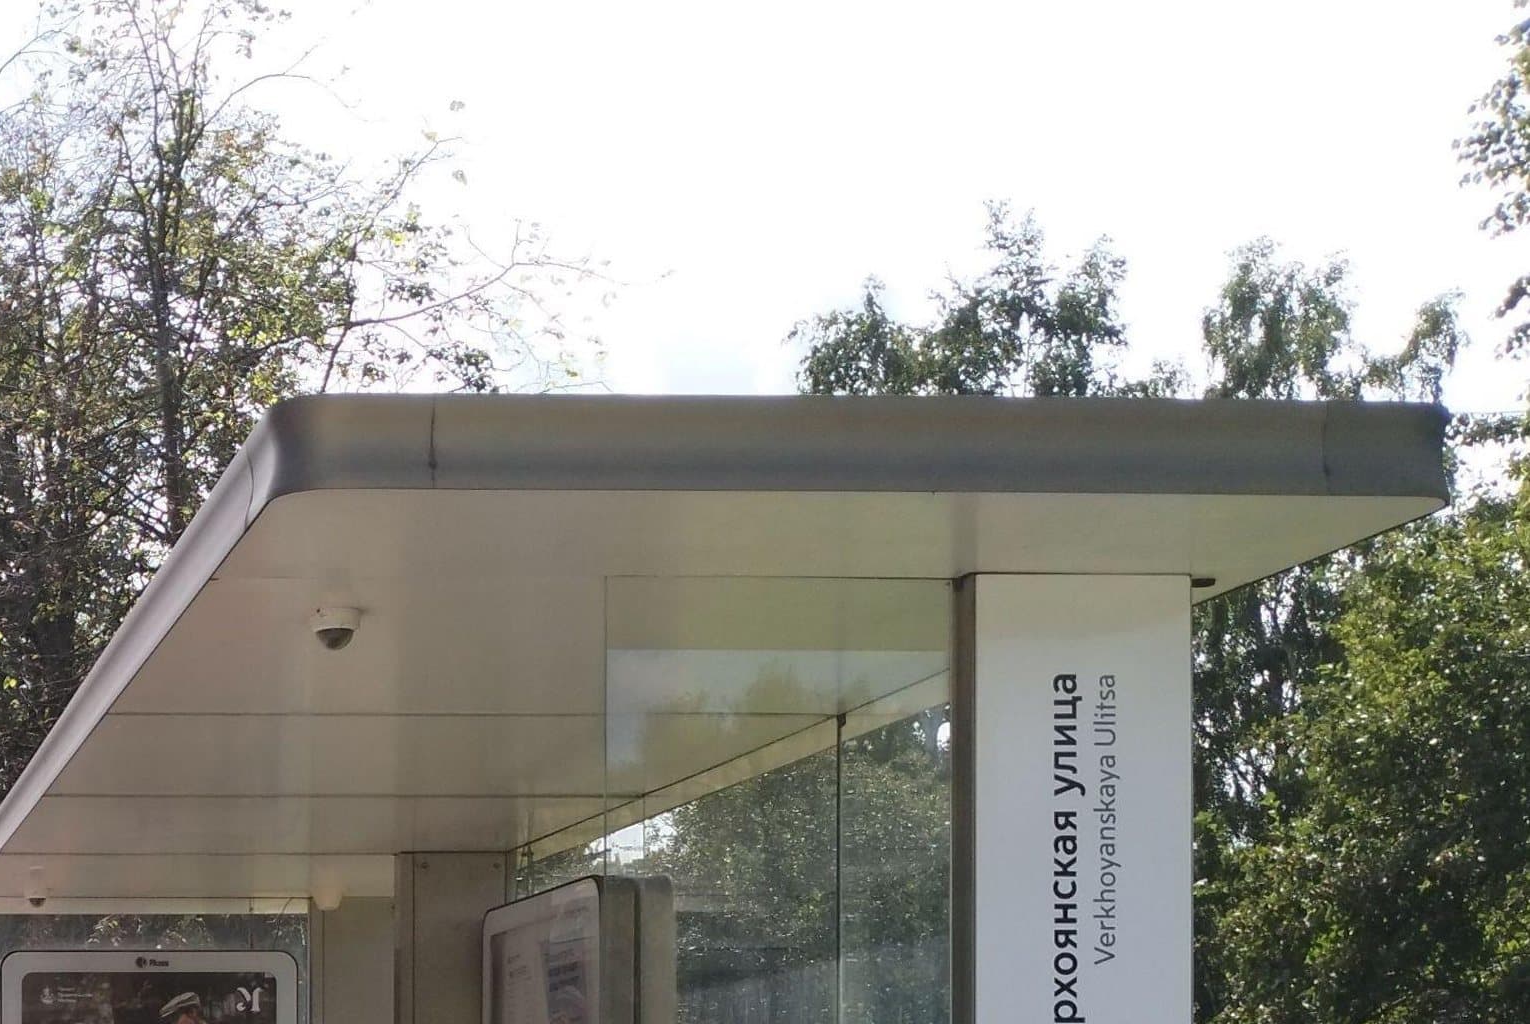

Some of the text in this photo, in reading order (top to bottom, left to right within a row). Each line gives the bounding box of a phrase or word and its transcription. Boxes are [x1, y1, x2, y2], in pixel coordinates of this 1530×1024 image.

[1052, 673, 1086, 797] улица
[1093, 674, 1122, 965] Verkhoyanskaya Ulitsa
